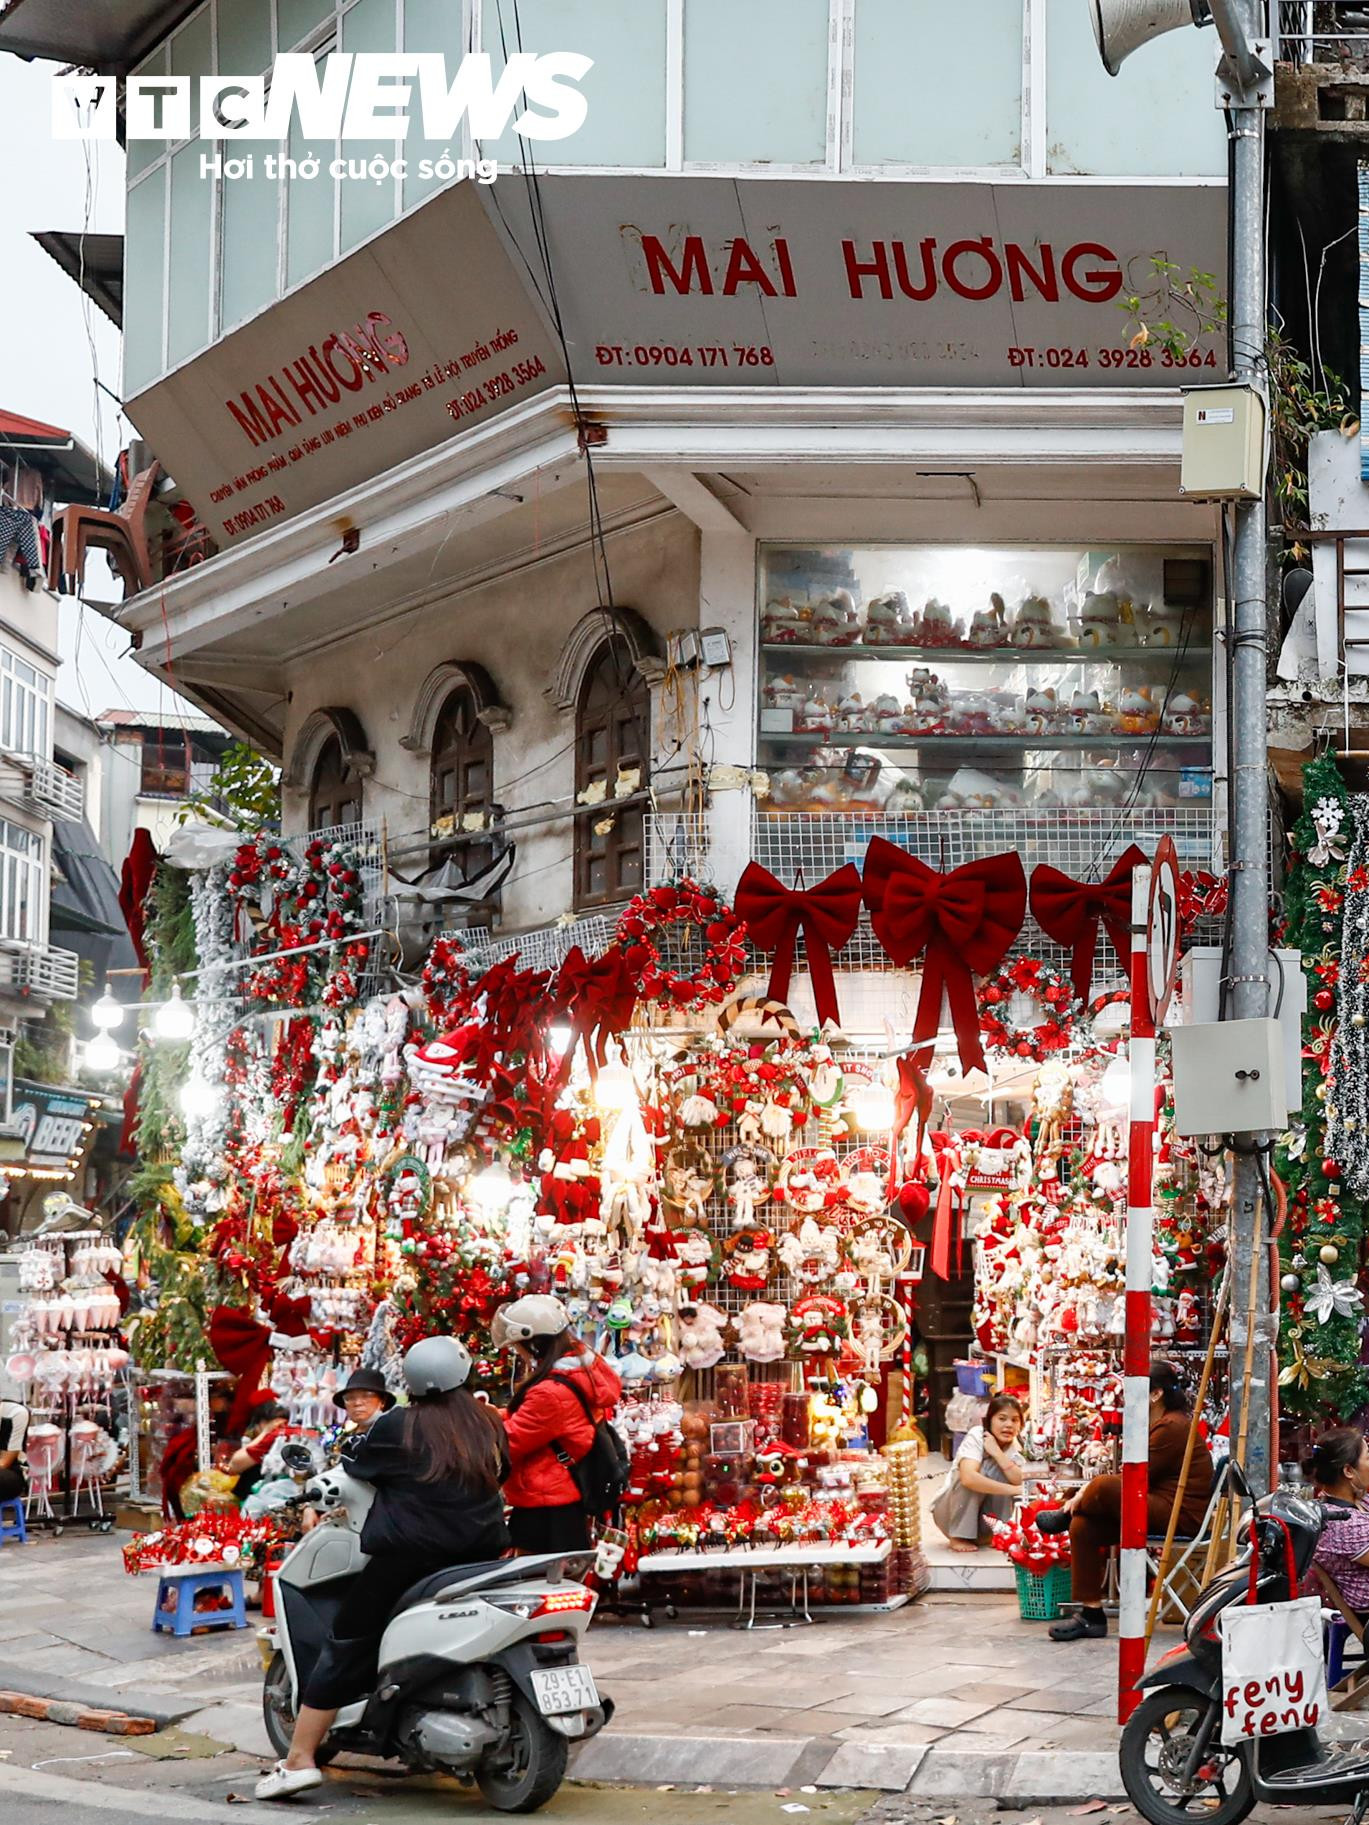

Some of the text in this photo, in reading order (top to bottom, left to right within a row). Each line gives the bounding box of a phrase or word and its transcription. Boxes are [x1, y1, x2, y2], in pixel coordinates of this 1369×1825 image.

[641, 236, 1124, 303] MAI HƯƠNG
[511, 355, 546, 386] 3564
[697, 347, 728, 366] 171
[733, 346, 774, 366] 768
[1098, 348, 1153, 368] 3928
[226, 312, 409, 447] MAI HƯƠNG
[542, 1686, 594, 1711] 853.71
[1224, 1670, 1304, 1718] feny
[1242, 1703, 1318, 1737] feny
